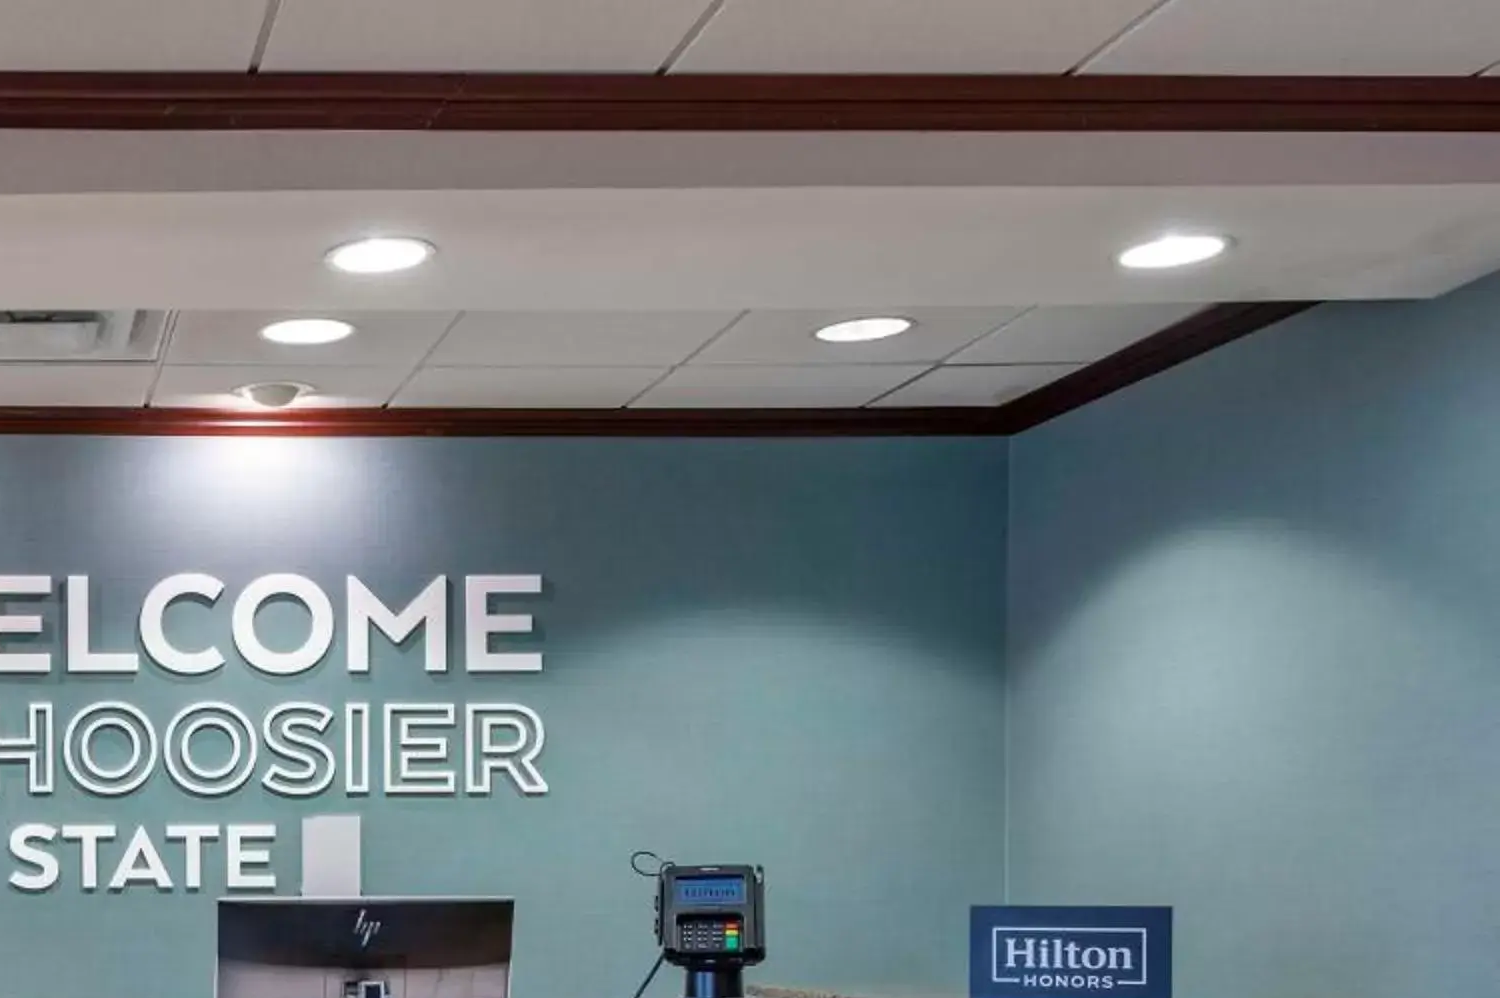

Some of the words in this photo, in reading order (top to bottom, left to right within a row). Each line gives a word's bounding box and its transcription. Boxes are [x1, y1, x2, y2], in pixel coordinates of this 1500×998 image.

[8, 823, 276, 891] STATE
[354, 909, 381, 946] hp
[1004, 937, 1133, 970] Hilton
[1023, 974, 1114, 989] HONORS
